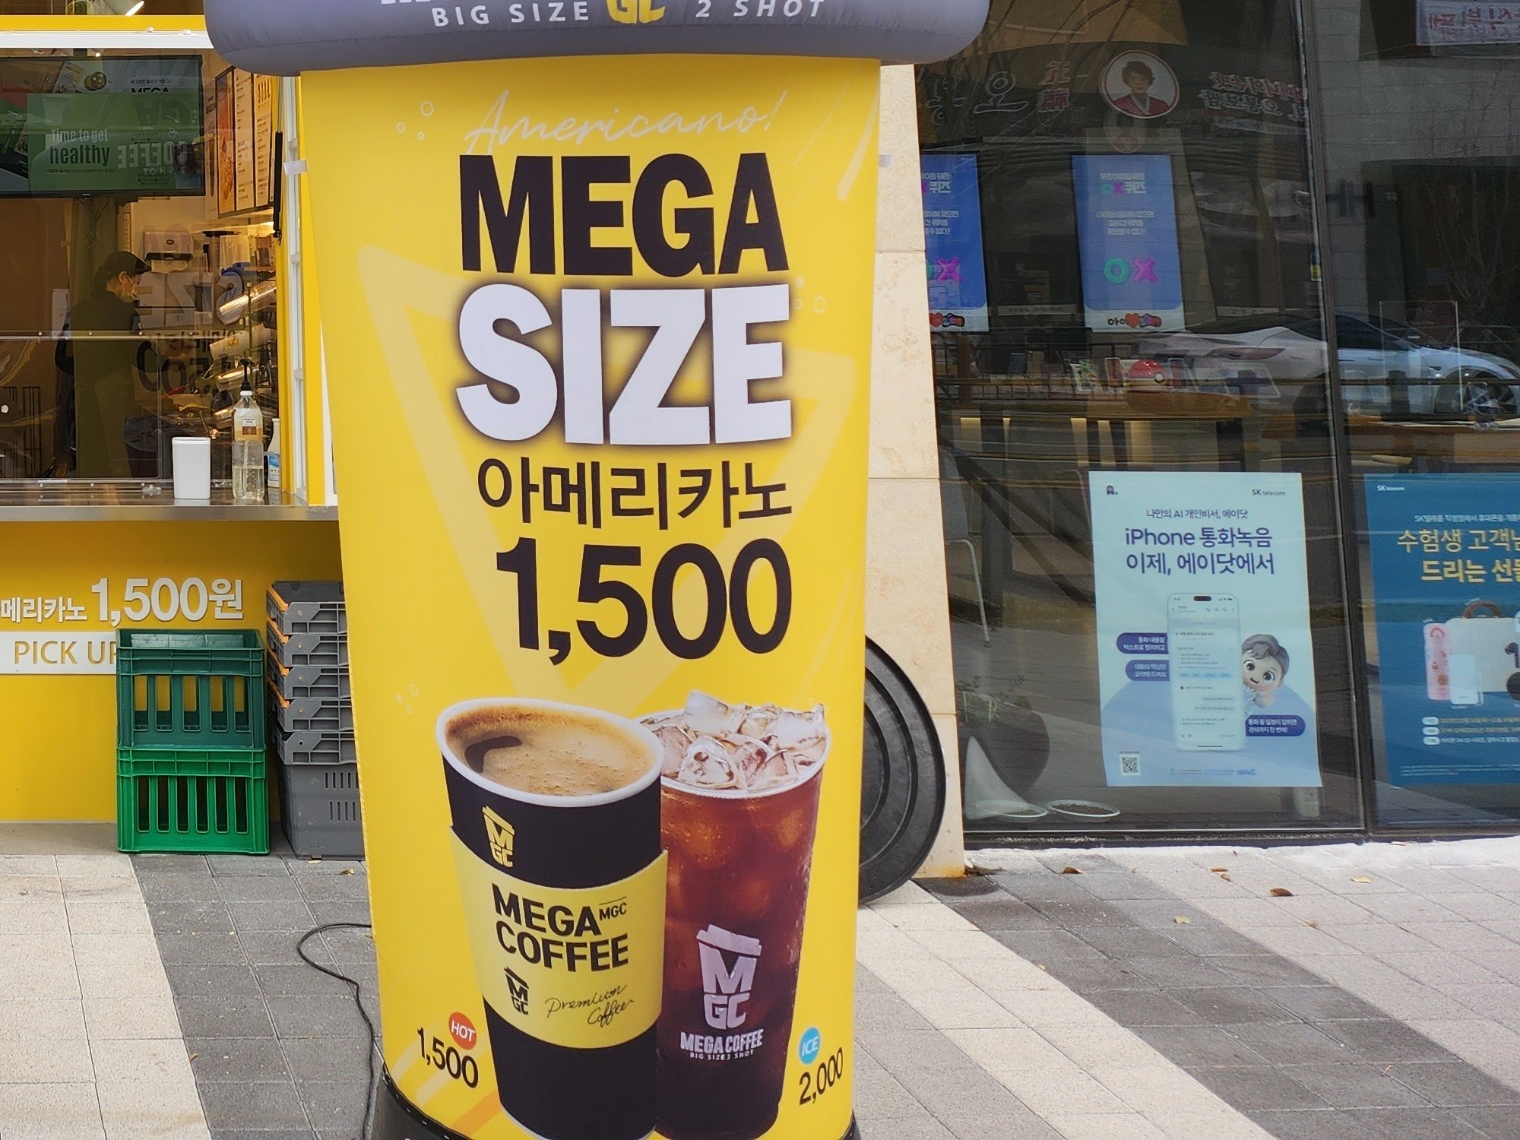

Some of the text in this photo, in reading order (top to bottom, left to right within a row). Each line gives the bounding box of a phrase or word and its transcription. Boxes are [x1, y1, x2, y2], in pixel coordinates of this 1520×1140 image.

[432, 3, 490, 27] BIG
[509, 0, 590, 24] SIZE
[466, 89, 785, 154] Americano!
[49, 144, 110, 167] healthy
[459, 153, 792, 278] MEGA
[455, 283, 792, 447] SIZE
[477, 456, 792, 531] 아메리카노
[1251, 488, 1262, 496] SK
[1146, 509, 1172, 518] 나만의
[1185, 509, 1221, 520] 개인비서,
[1125, 527, 1273, 547] iPhone 통화녹음
[1397, 528, 1463, 553] 수험생
[1126, 552, 1275, 576] 이제, 에이닷에서
[1421, 558, 1487, 583] 드리는
[91, 576, 244, 627] 1,500원
[495, 536, 792, 666] 1,500
[14, 640, 78, 665] PICK
[493, 883, 628, 937] MEGA MGC
[496, 922, 629, 972] COFFEE
[450, 1020, 477, 1041] HOT
[679, 1028, 764, 1055] MEGA COFFEE
[416, 1026, 479, 1089] 1,500
[689, 1051, 705, 1061] BIG
[733, 1048, 755, 1058] SHOT
[800, 1034, 820, 1055] ICE
[798, 1046, 845, 1105] 2,000
